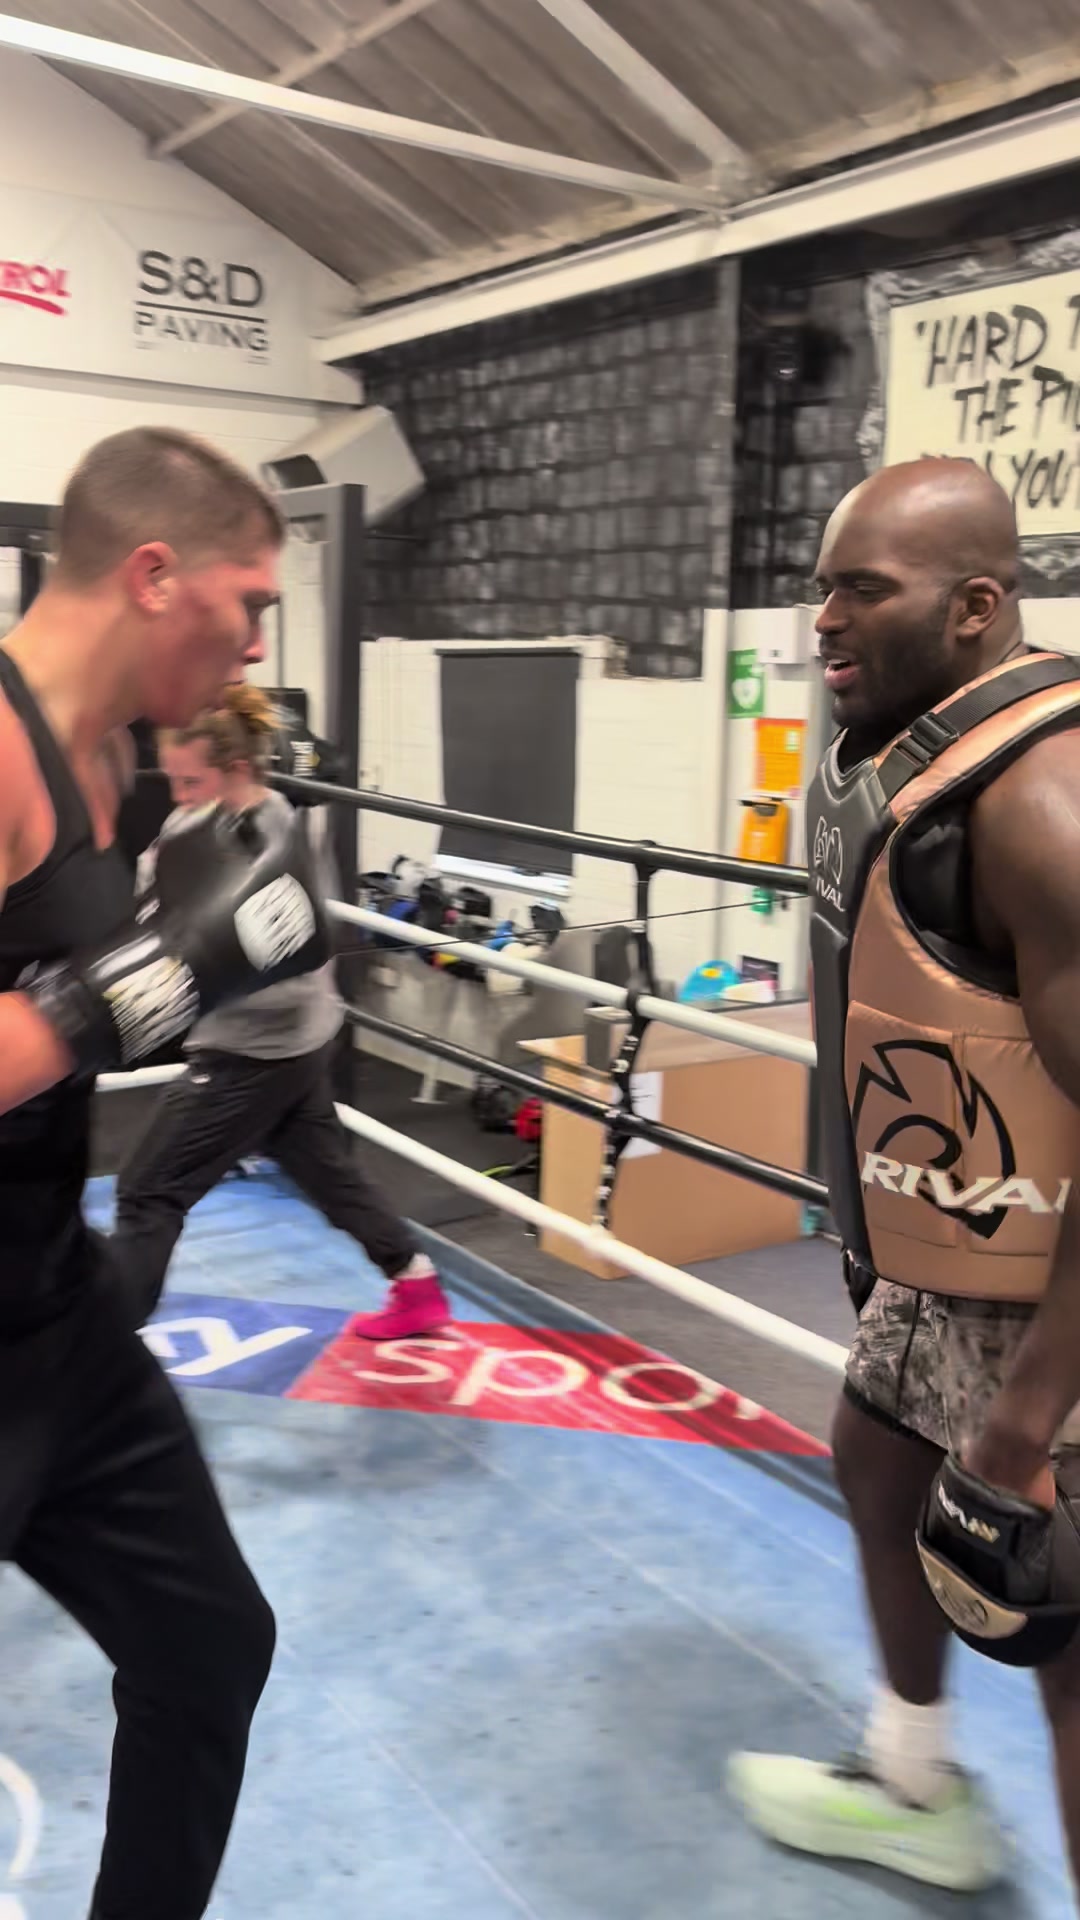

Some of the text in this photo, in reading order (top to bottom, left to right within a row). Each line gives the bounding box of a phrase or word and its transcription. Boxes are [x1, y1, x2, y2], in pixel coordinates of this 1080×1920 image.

[0, 261, 71, 297] ROL
[138, 249, 264, 307] S&D
[133, 310, 268, 351] PAVING
[954, 378, 1024, 443] THE
[813, 876, 846, 912] IVAL
